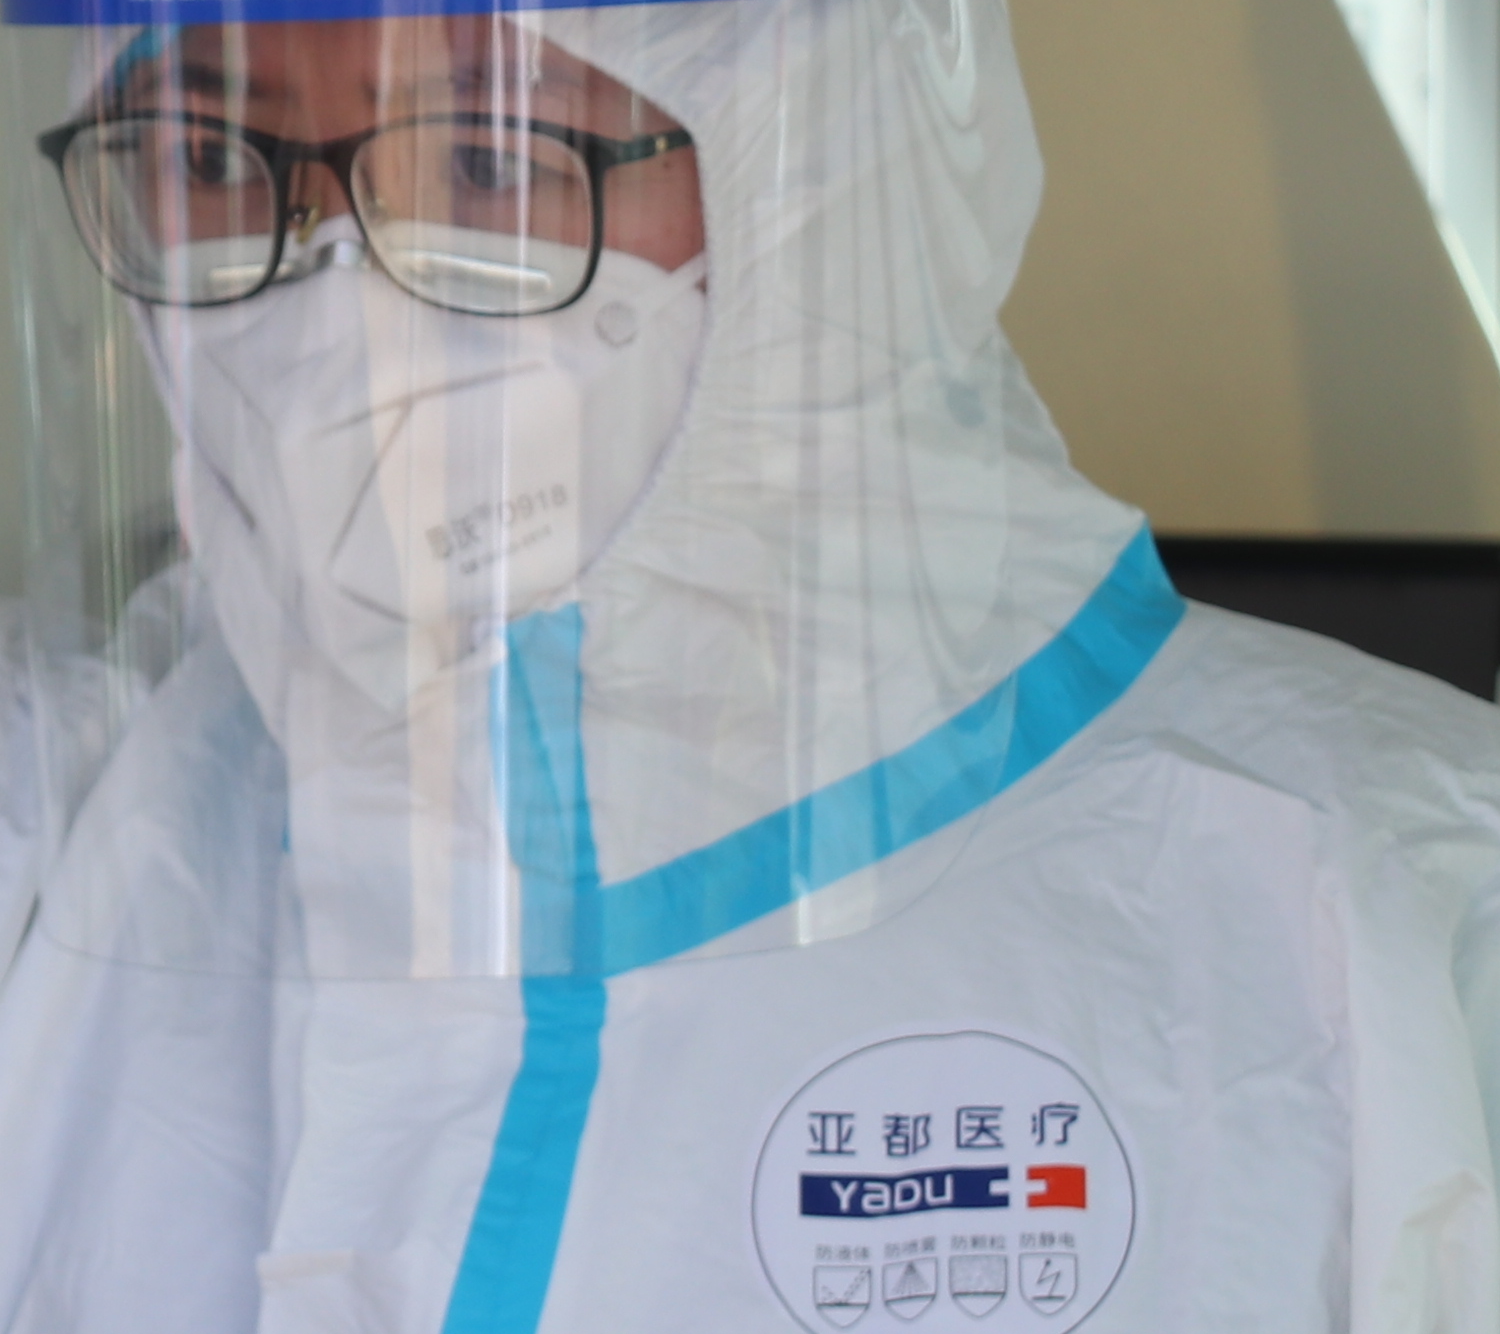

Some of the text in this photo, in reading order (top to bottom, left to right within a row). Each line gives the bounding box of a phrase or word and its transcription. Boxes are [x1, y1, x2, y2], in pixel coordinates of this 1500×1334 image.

[806, 1102, 1080, 1157] 亚都医疗
[1019, 1231, 1076, 1249] 防静电
